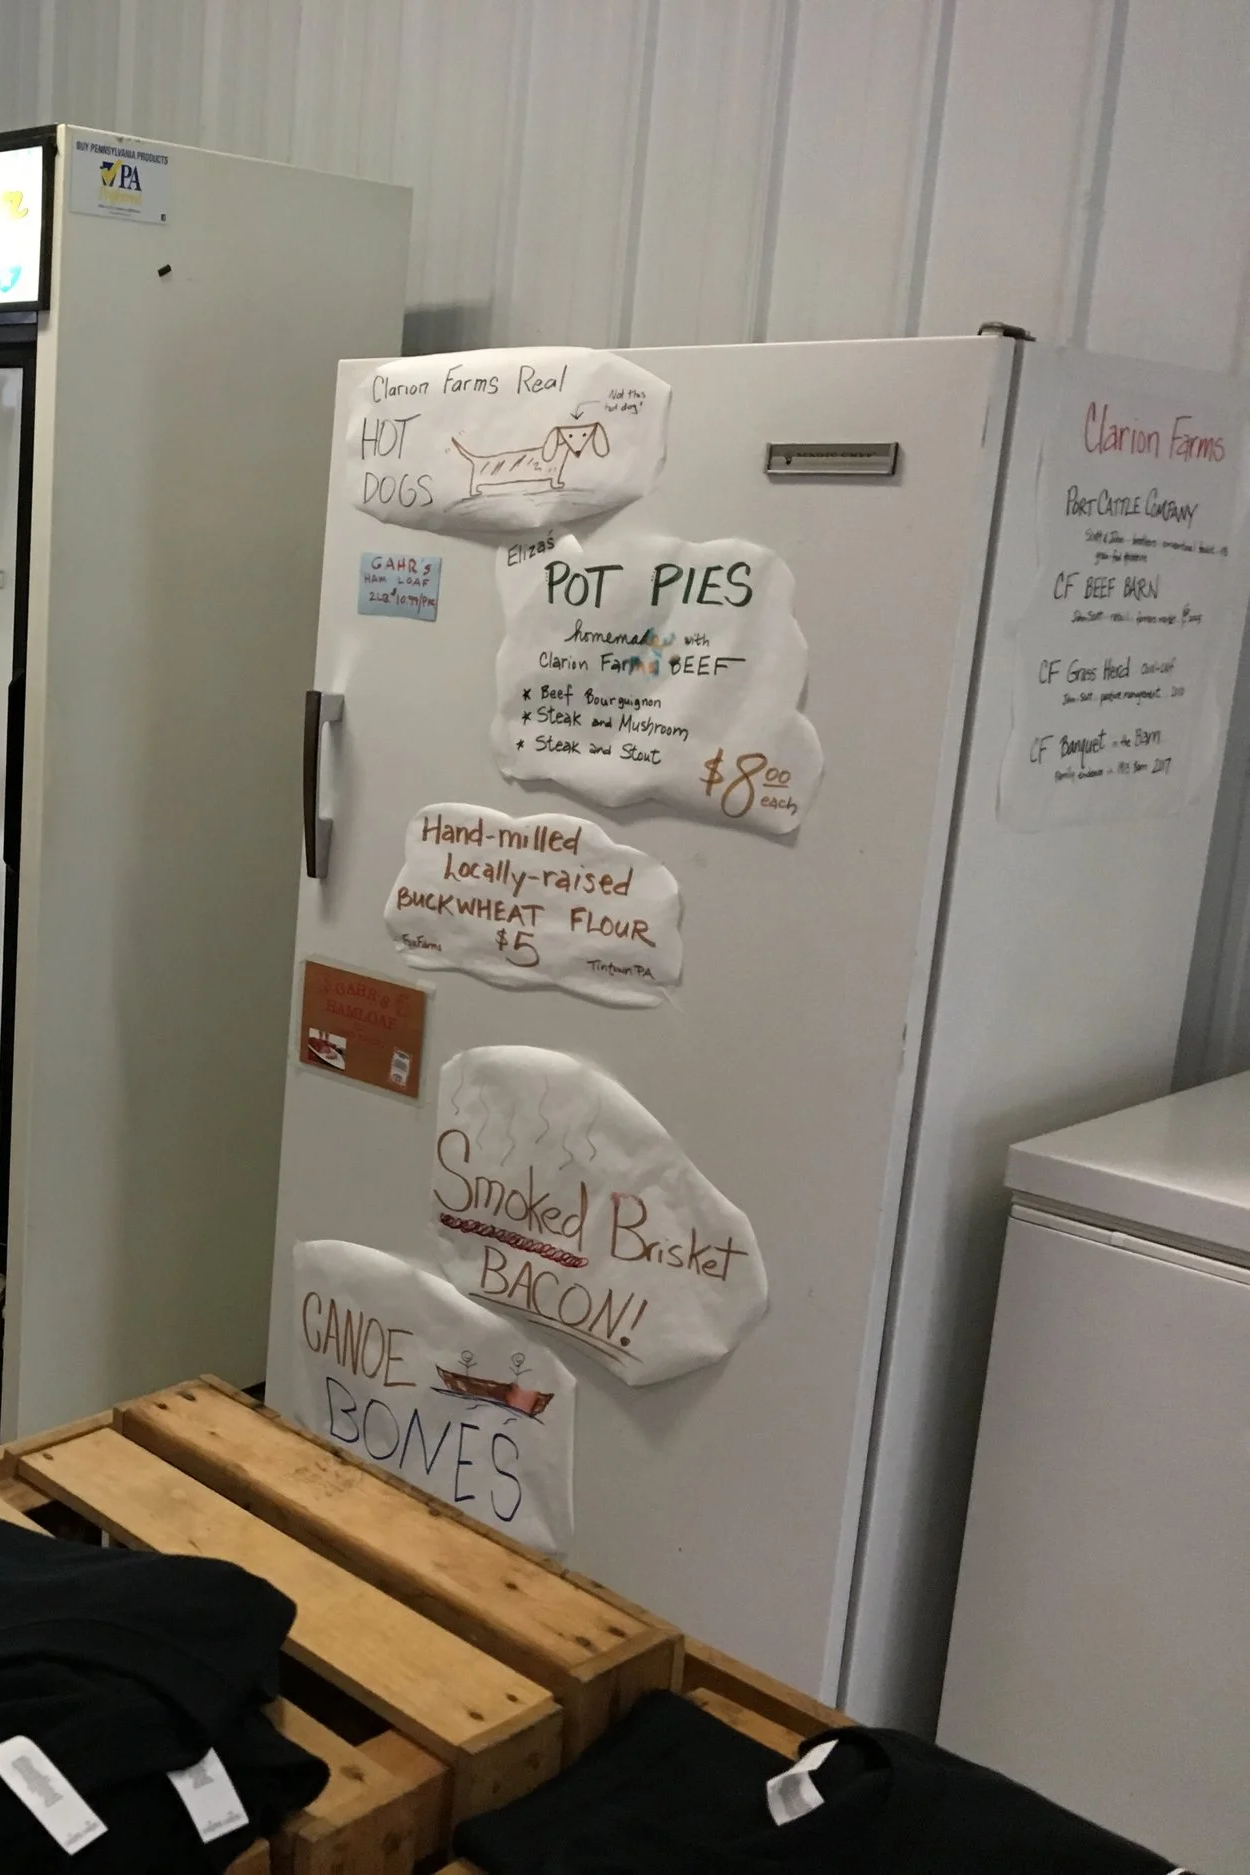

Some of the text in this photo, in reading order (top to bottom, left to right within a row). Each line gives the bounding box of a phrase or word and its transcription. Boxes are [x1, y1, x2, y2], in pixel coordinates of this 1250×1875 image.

[76, 140, 169, 165] BUY PENNSYLVANIA PRODUCTS
[119, 164, 142, 191] PA
[372, 364, 568, 403] Clarion Farms Real
[361, 413, 422, 460] HOT
[1084, 401, 1227, 463] Clarion Farms
[363, 472, 434, 508] DOGS
[364, 573, 430, 587] HAM LOAF
[544, 560, 753, 608] POT PIES
[1053, 571, 1160, 601] CF BEEF BARN
[684, 633, 710, 648] with
[539, 651, 589, 672] Clarion
[669, 654, 746, 677] BEEF
[1038, 659, 1061, 684] CF
[1066, 658, 1097, 683] Grass
[1103, 656, 1131, 681] Herd
[540, 684, 574, 706] Beef
[536, 706, 689, 741] Steak and Mushroom
[534, 735, 662, 766] Steak and Stout
[1029, 734, 1054, 764] CF
[1059, 729, 1107, 769] Banquet
[760, 795, 798, 815] each
[421, 813, 583, 856] Hand-milled
[396, 886, 656, 948] BUCKWHEAT FLOUR
[495, 928, 540, 967] $5
[434, 1129, 589, 1252] Smoked
[611, 1192, 749, 1282] Brisket
[480, 1245, 649, 1347] BACON!
[302, 1291, 417, 1387] CANOE
[326, 1376, 522, 1523] BONES
